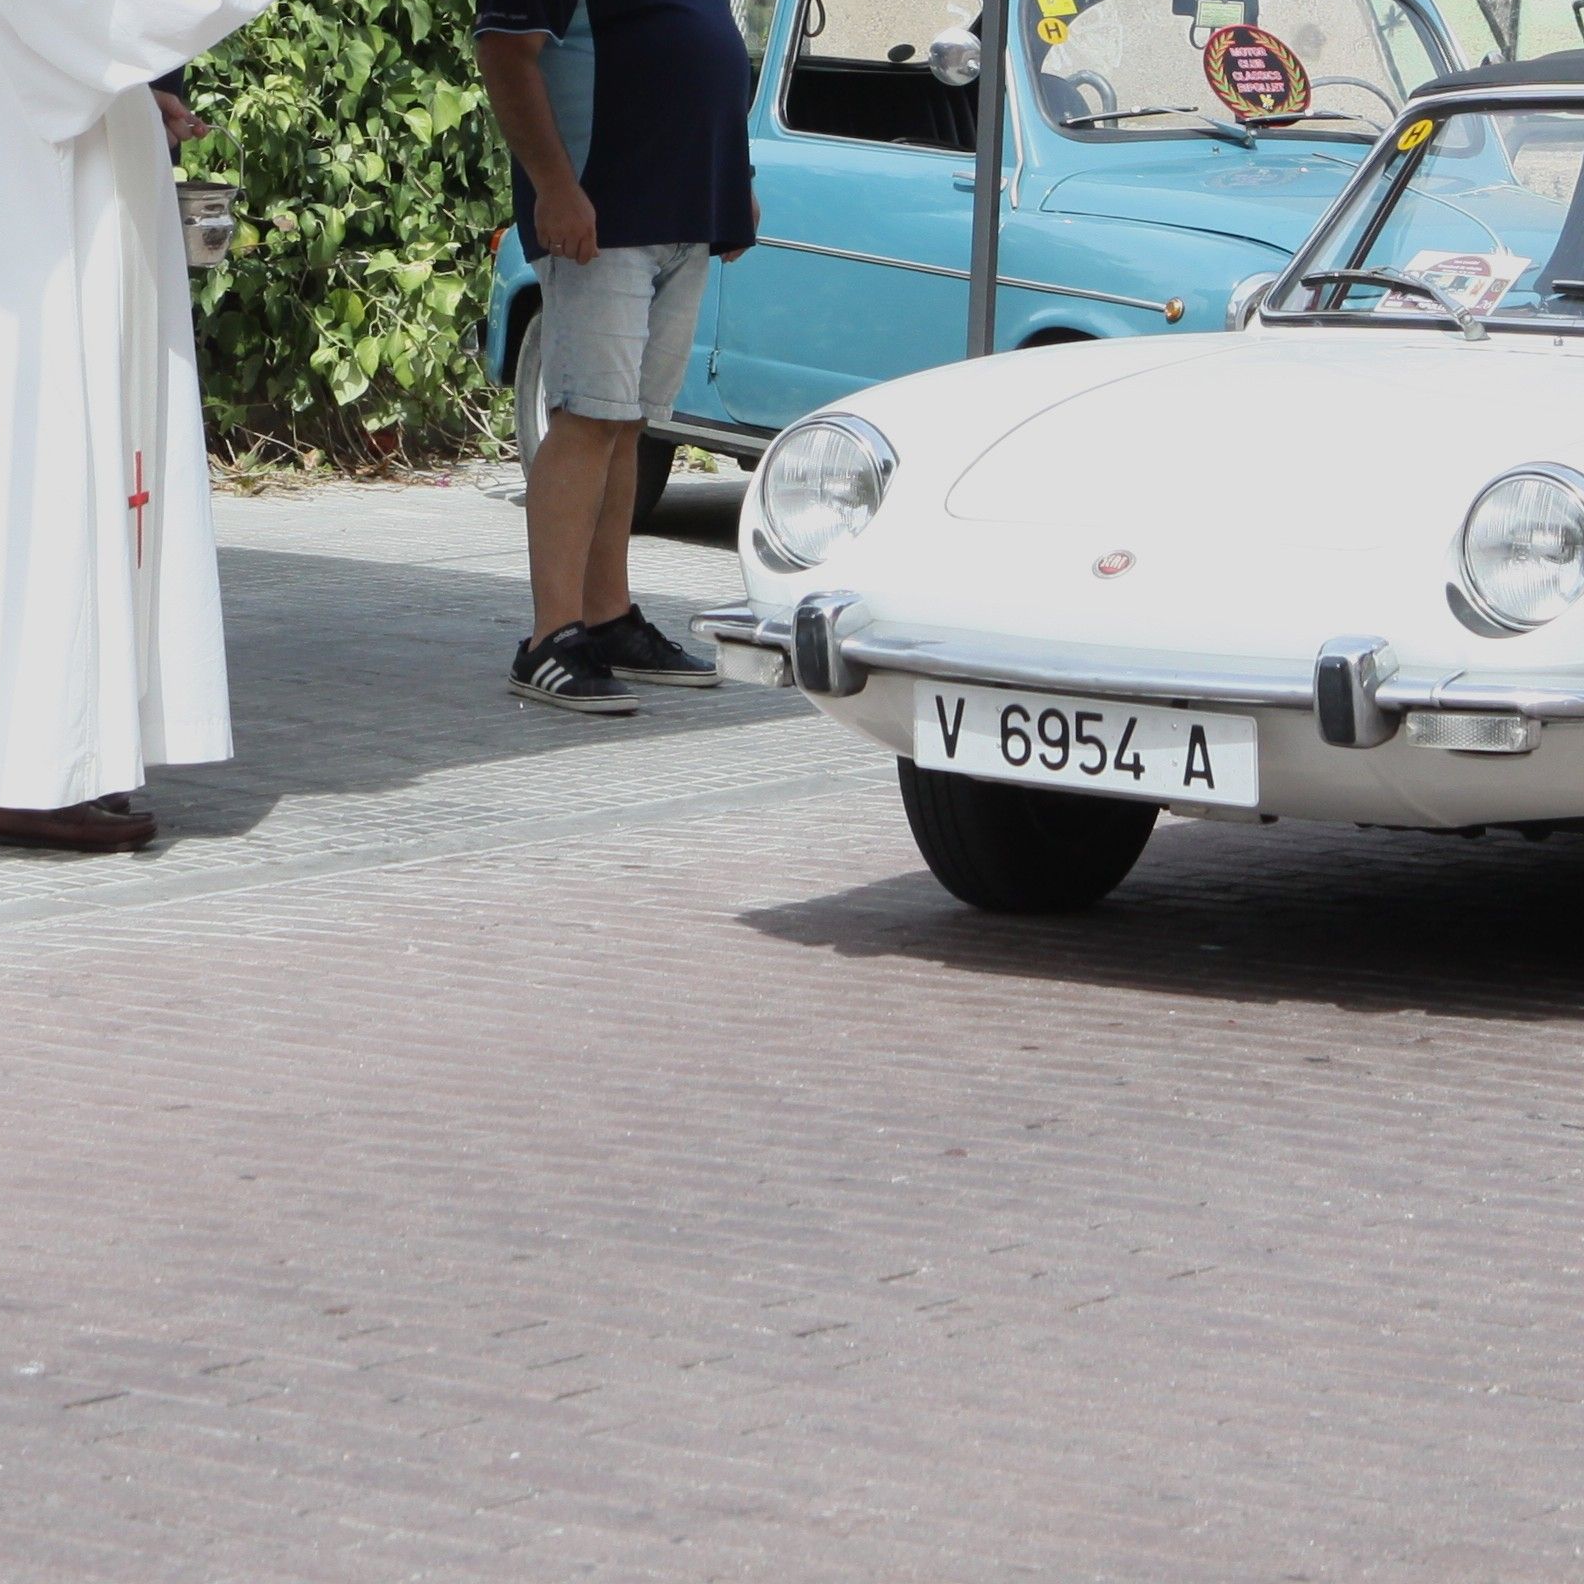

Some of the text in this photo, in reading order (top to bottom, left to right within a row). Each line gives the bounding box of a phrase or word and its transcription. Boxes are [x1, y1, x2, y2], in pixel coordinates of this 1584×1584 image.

[1044, 22, 1061, 40] H
[1405, 124, 1427, 144] H
[935, 695, 1215, 790] V 6954 A
